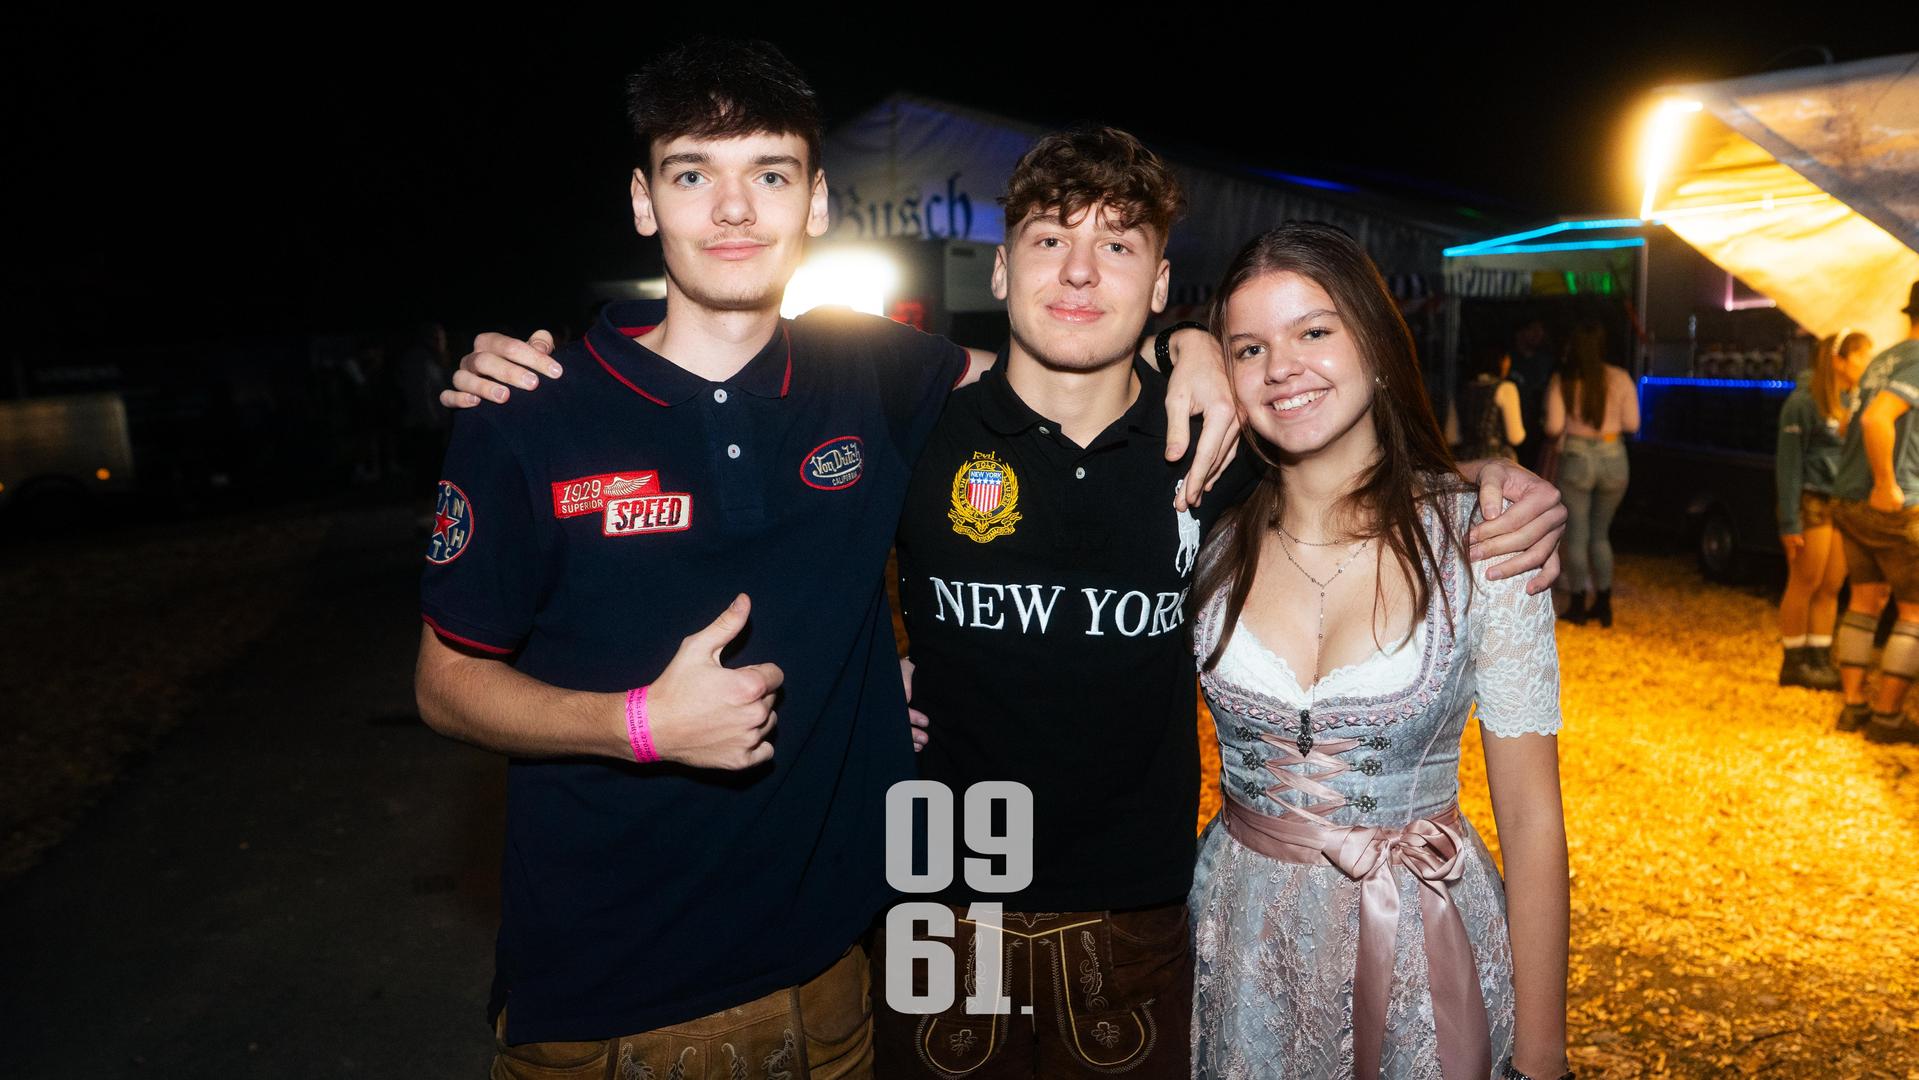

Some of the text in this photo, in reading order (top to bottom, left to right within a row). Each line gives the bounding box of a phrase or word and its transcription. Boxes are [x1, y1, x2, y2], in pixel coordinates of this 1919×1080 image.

[810, 455, 837, 475] Von
[985, 471, 1002, 479] YORK
[560, 480, 602, 503] 1929
[561, 500, 604, 514] SUPERIOR
[612, 498, 682, 530] SPEED
[929, 576, 1190, 637] NEW YORK
